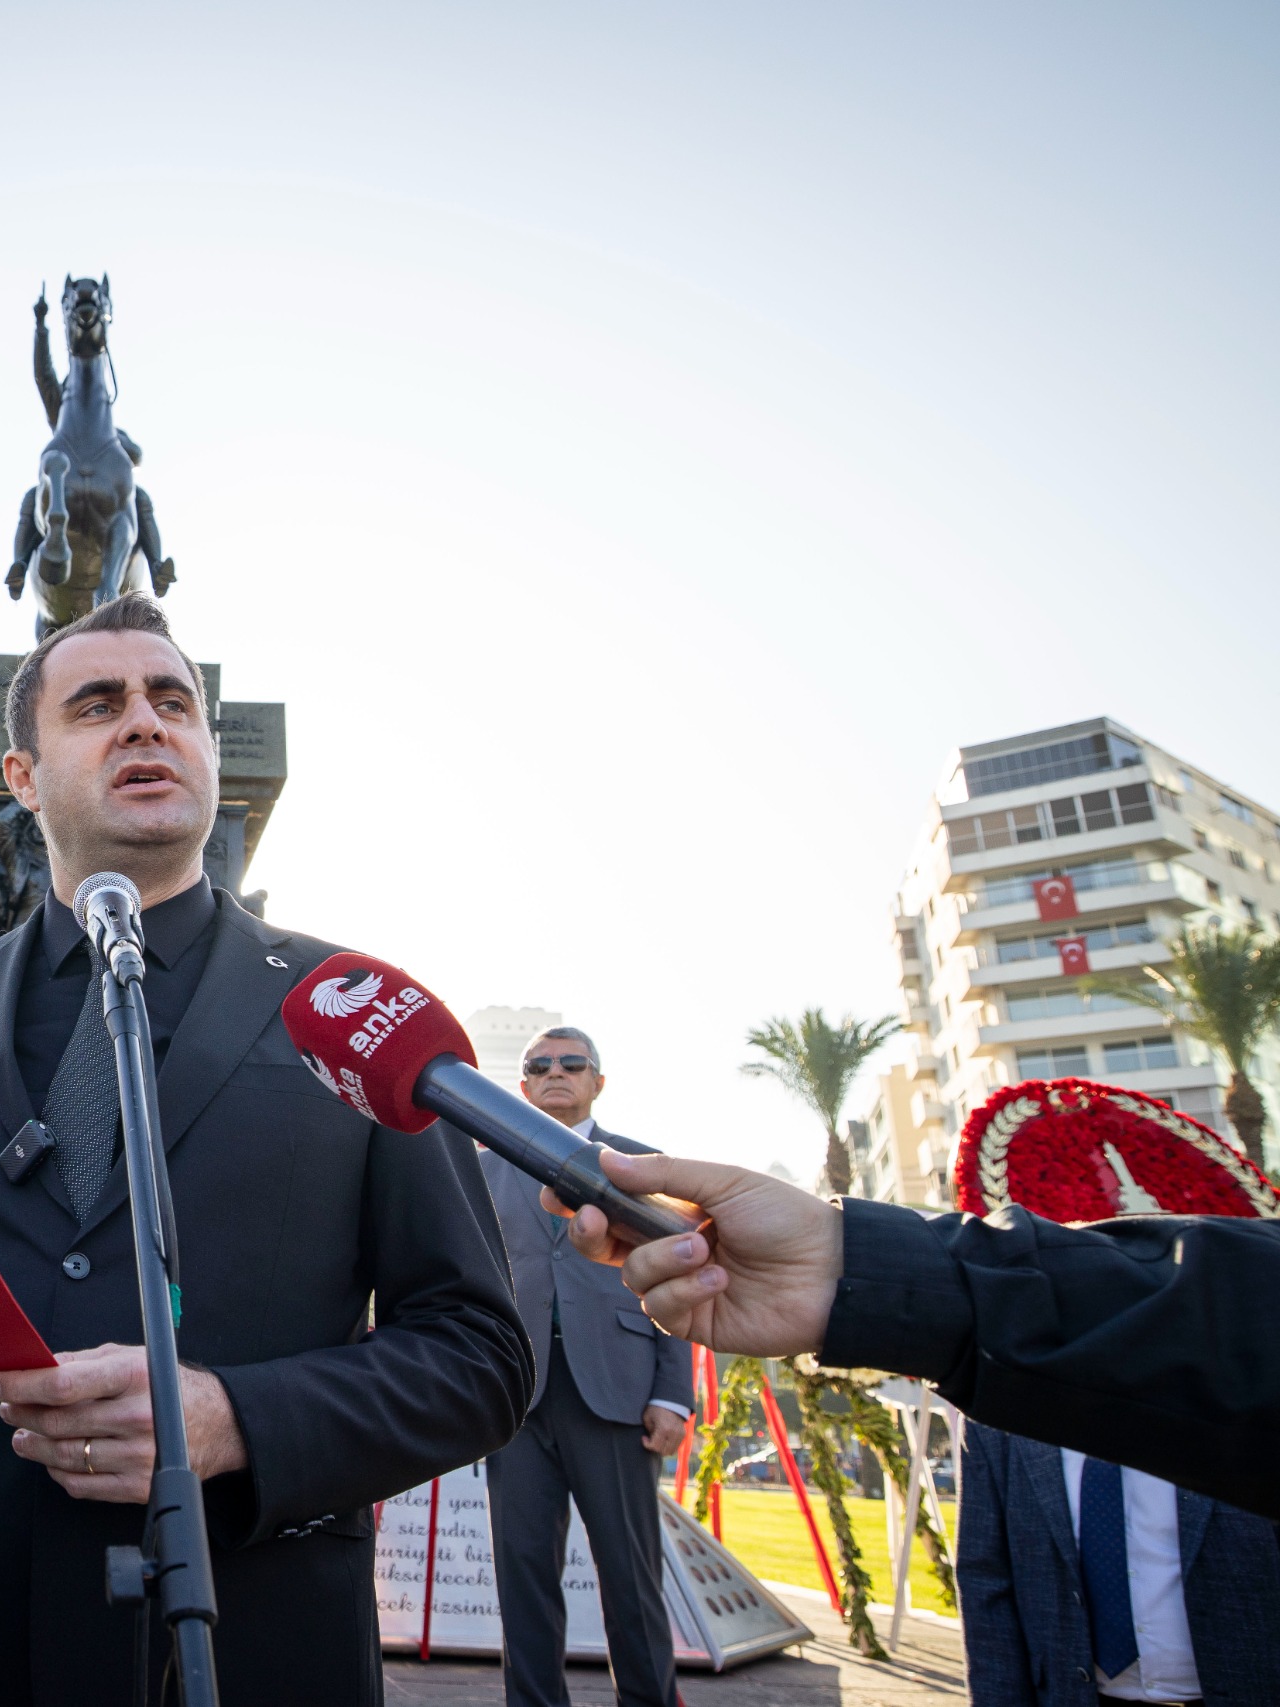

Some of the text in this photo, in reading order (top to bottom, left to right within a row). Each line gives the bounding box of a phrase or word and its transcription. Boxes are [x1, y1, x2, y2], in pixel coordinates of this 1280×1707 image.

[348, 987, 424, 1053] anka
[361, 997, 430, 1059] HABER AJANSI
[449, 1498, 488, 1514] yen
[398, 1522, 485, 1539] sizndir.
